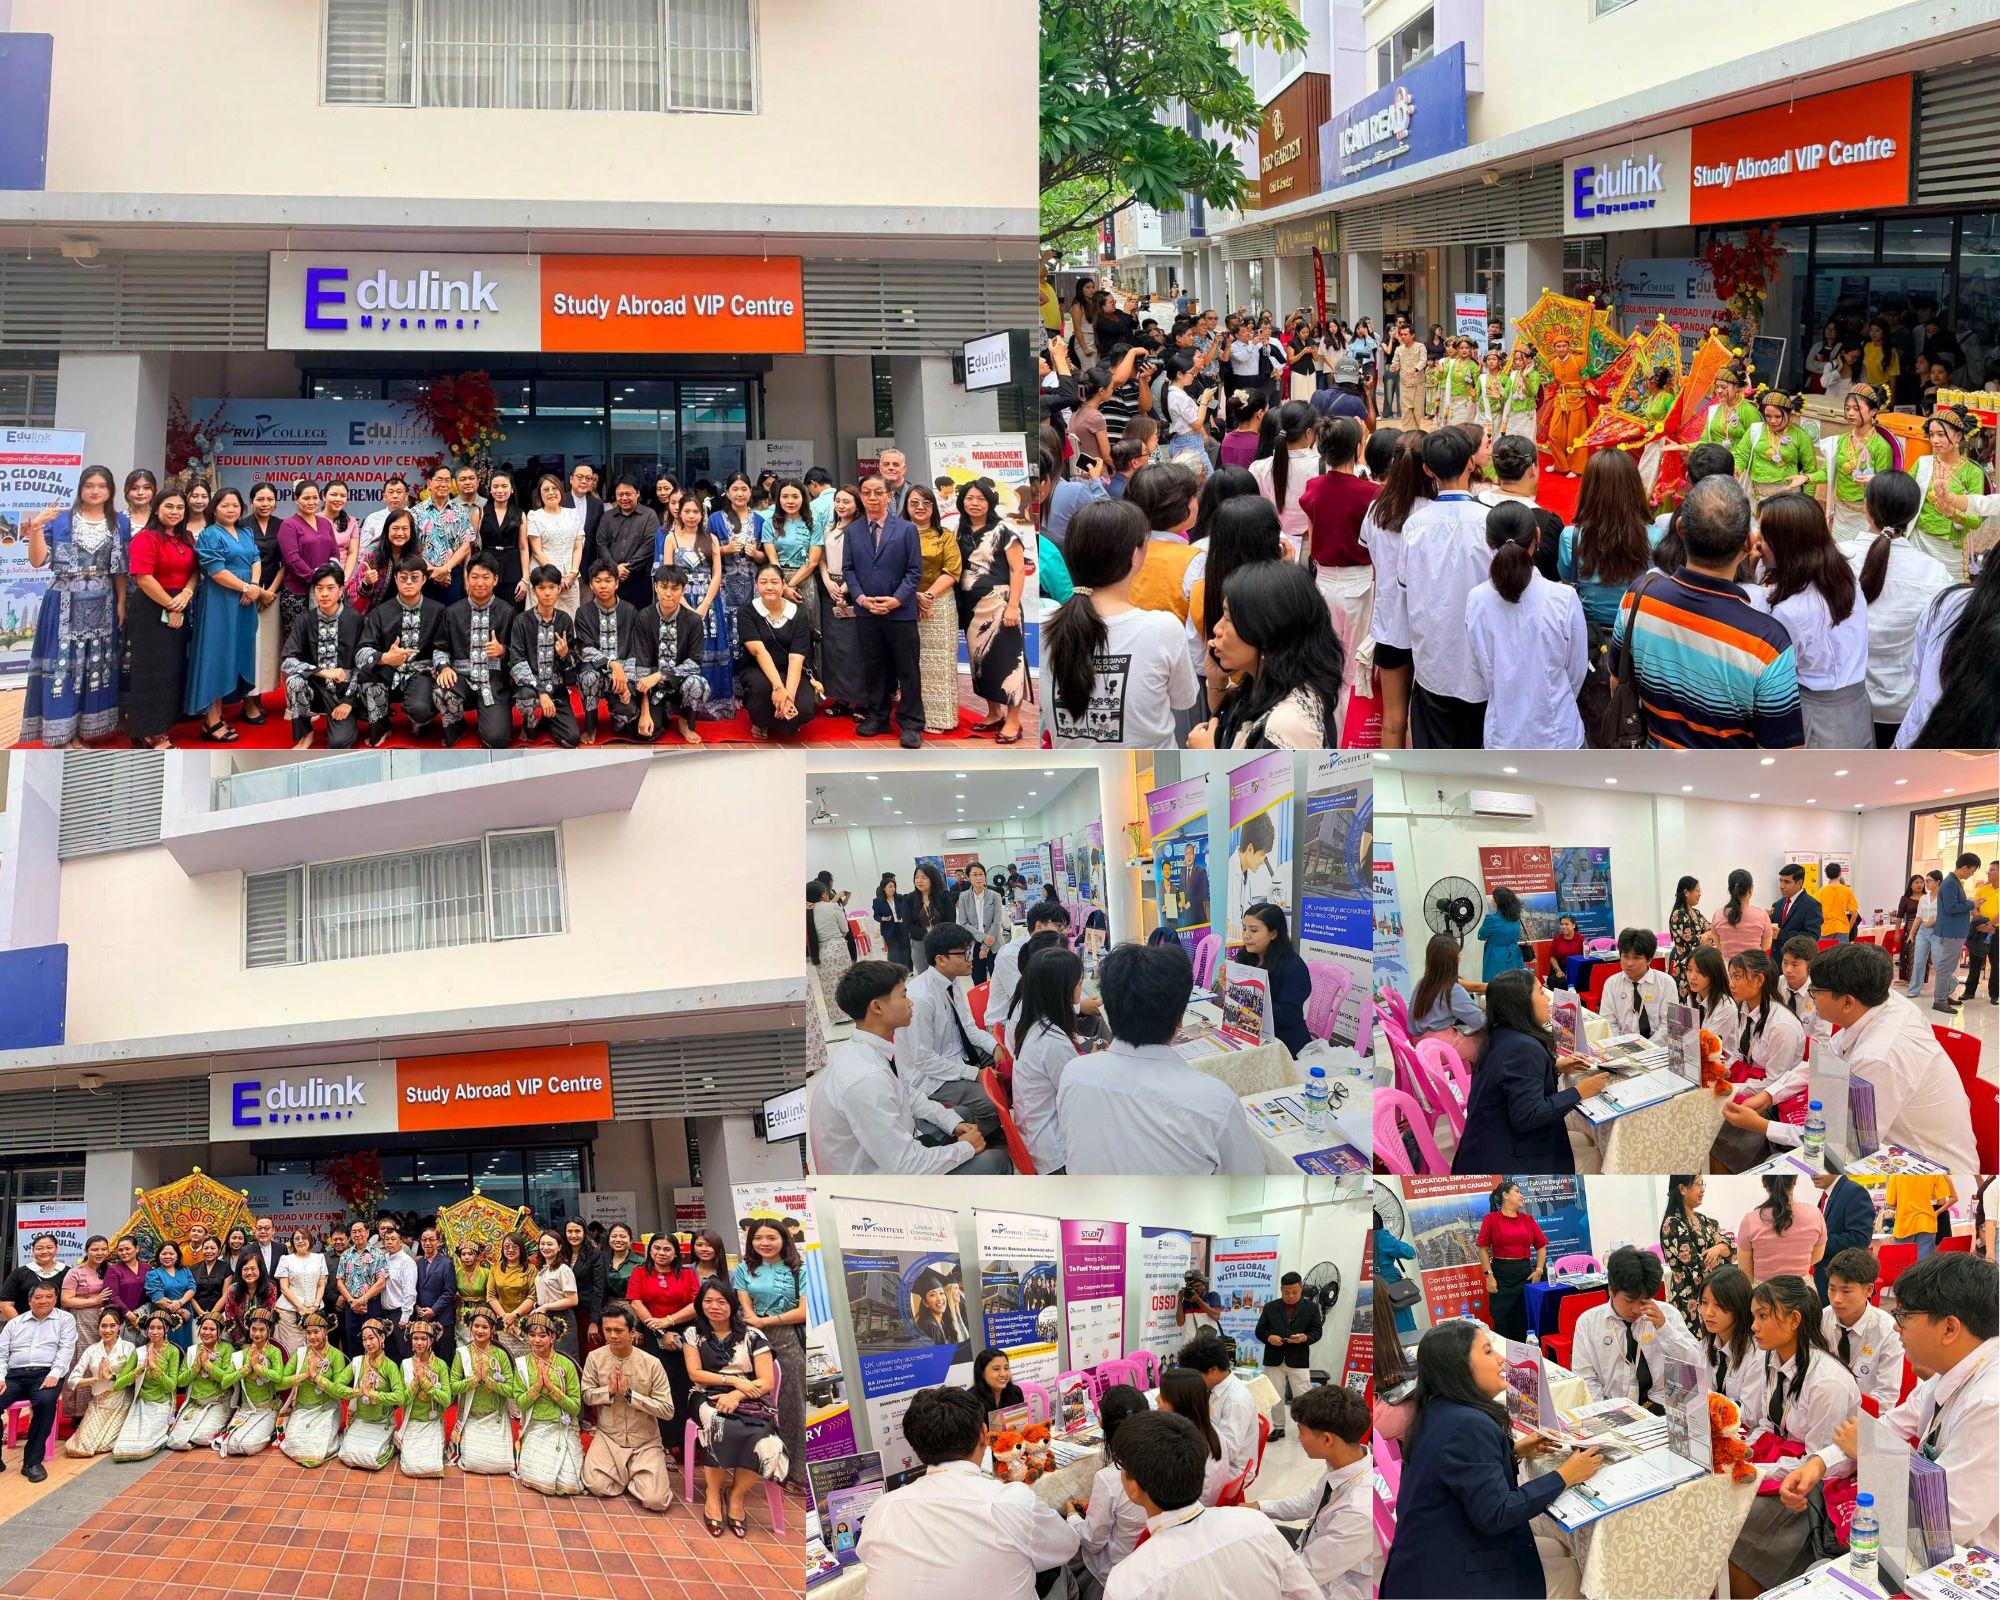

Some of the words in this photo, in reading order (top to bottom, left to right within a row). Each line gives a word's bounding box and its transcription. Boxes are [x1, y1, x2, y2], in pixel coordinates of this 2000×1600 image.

[1694, 165, 1734, 188] Study
[1735, 149, 1793, 180] Abroad
[1795, 143, 1826, 170] VIP
[1828, 135, 1897, 166] Centre
[1573, 154, 1664, 219] Edulink
[1596, 199, 1656, 217] Myanmar
[304, 268, 500, 331] Edulink
[553, 293, 610, 320] Study
[616, 293, 687, 316] Abroad
[693, 295, 725, 316] VIP
[731, 294, 794, 316] Centre
[1669, 306, 1698, 317] ABROAD
[1700, 308, 1711, 318] VIP
[360, 315, 481, 331] Myanmar
[967, 349, 1009, 375] Edulink
[272, 429, 328, 438] COLLEGE
[215, 455, 270, 466] EDULINK
[274, 455, 312, 466] STUDY
[316, 455, 371, 466] ABROAD
[374, 455, 393, 466] VIP
[971, 450, 1023, 460] MANAGEMENT
[982, 460, 1025, 470] FOUNDATION
[11, 468, 63, 483] GLOBAL
[264, 471, 332, 482] MINGALAR
[998, 468, 1025, 477] STUDIES
[14, 481, 74, 498] EDULINK
[1338, 752, 1372, 766] INSTITUTE
[1304, 910, 1326, 918] business
[1326, 913, 1348, 921] degree
[406, 1085, 450, 1105] Study
[455, 1079, 511, 1100] Abroad
[515, 1077, 543, 1096] VIP
[548, 1075, 603, 1094] Centre
[231, 1074, 366, 1127] Edulink
[269, 1110, 354, 1125] Myanmar
[1410, 1176, 1449, 1186] EDUCATION,
[1529, 1179, 1548, 1187] Future
[1548, 1178, 1568, 1186] Begins
[1413, 1187, 1428, 1195] AND
[1428, 1184, 1460, 1193] RESIDENT
[1466, 1182, 1493, 1190] CANADA
[1540, 1184, 1564, 1192] Zealand
[299, 1213, 313, 1221] VIP
[45, 1230, 76, 1240] GLOBAL
[873, 1226, 904, 1234] INSTITUTE
[1224, 1264, 1236, 1273] GO
[1236, 1262, 1267, 1272] GLOBAL
[1216, 1271, 1238, 1282] WITH
[1239, 1270, 1273, 1282] EDULINK
[1427, 1274, 1458, 1285] Contact
[1458, 1272, 1471, 1280] Us:
[1151, 1294, 1177, 1311] OSSD
[865, 1366, 893, 1376] business
[894, 1362, 913, 1372] degree
[877, 1377, 894, 1386] (Hons)
[894, 1373, 915, 1382] Business
[868, 1381, 905, 1392] Administration
[879, 1399, 901, 1407] SHARPEN
